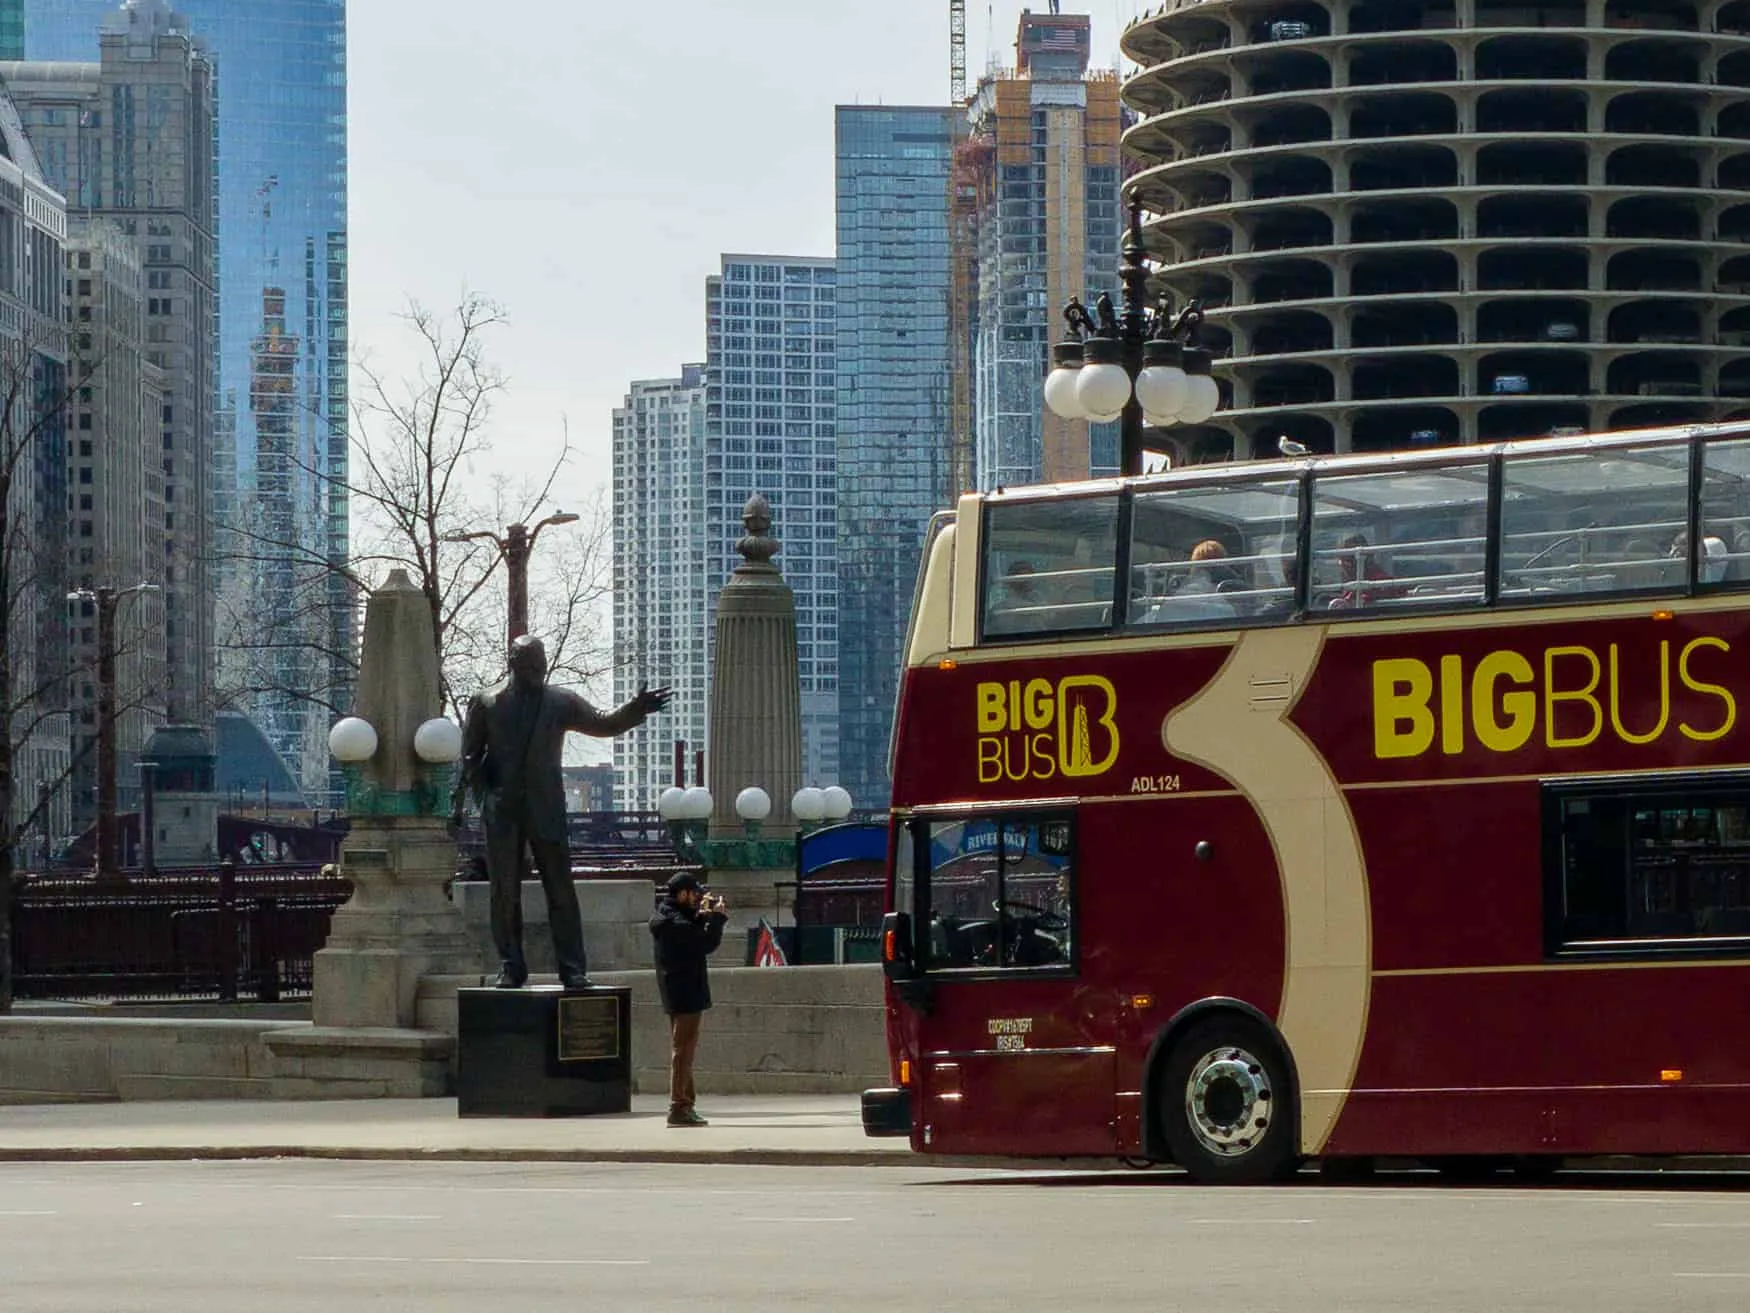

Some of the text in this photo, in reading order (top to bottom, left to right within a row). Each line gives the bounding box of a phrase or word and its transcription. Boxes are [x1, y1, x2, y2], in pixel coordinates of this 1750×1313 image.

[977, 678, 1054, 733] BIG
[978, 733, 1055, 783] BUS
[1131, 775, 1180, 793] ADL124
